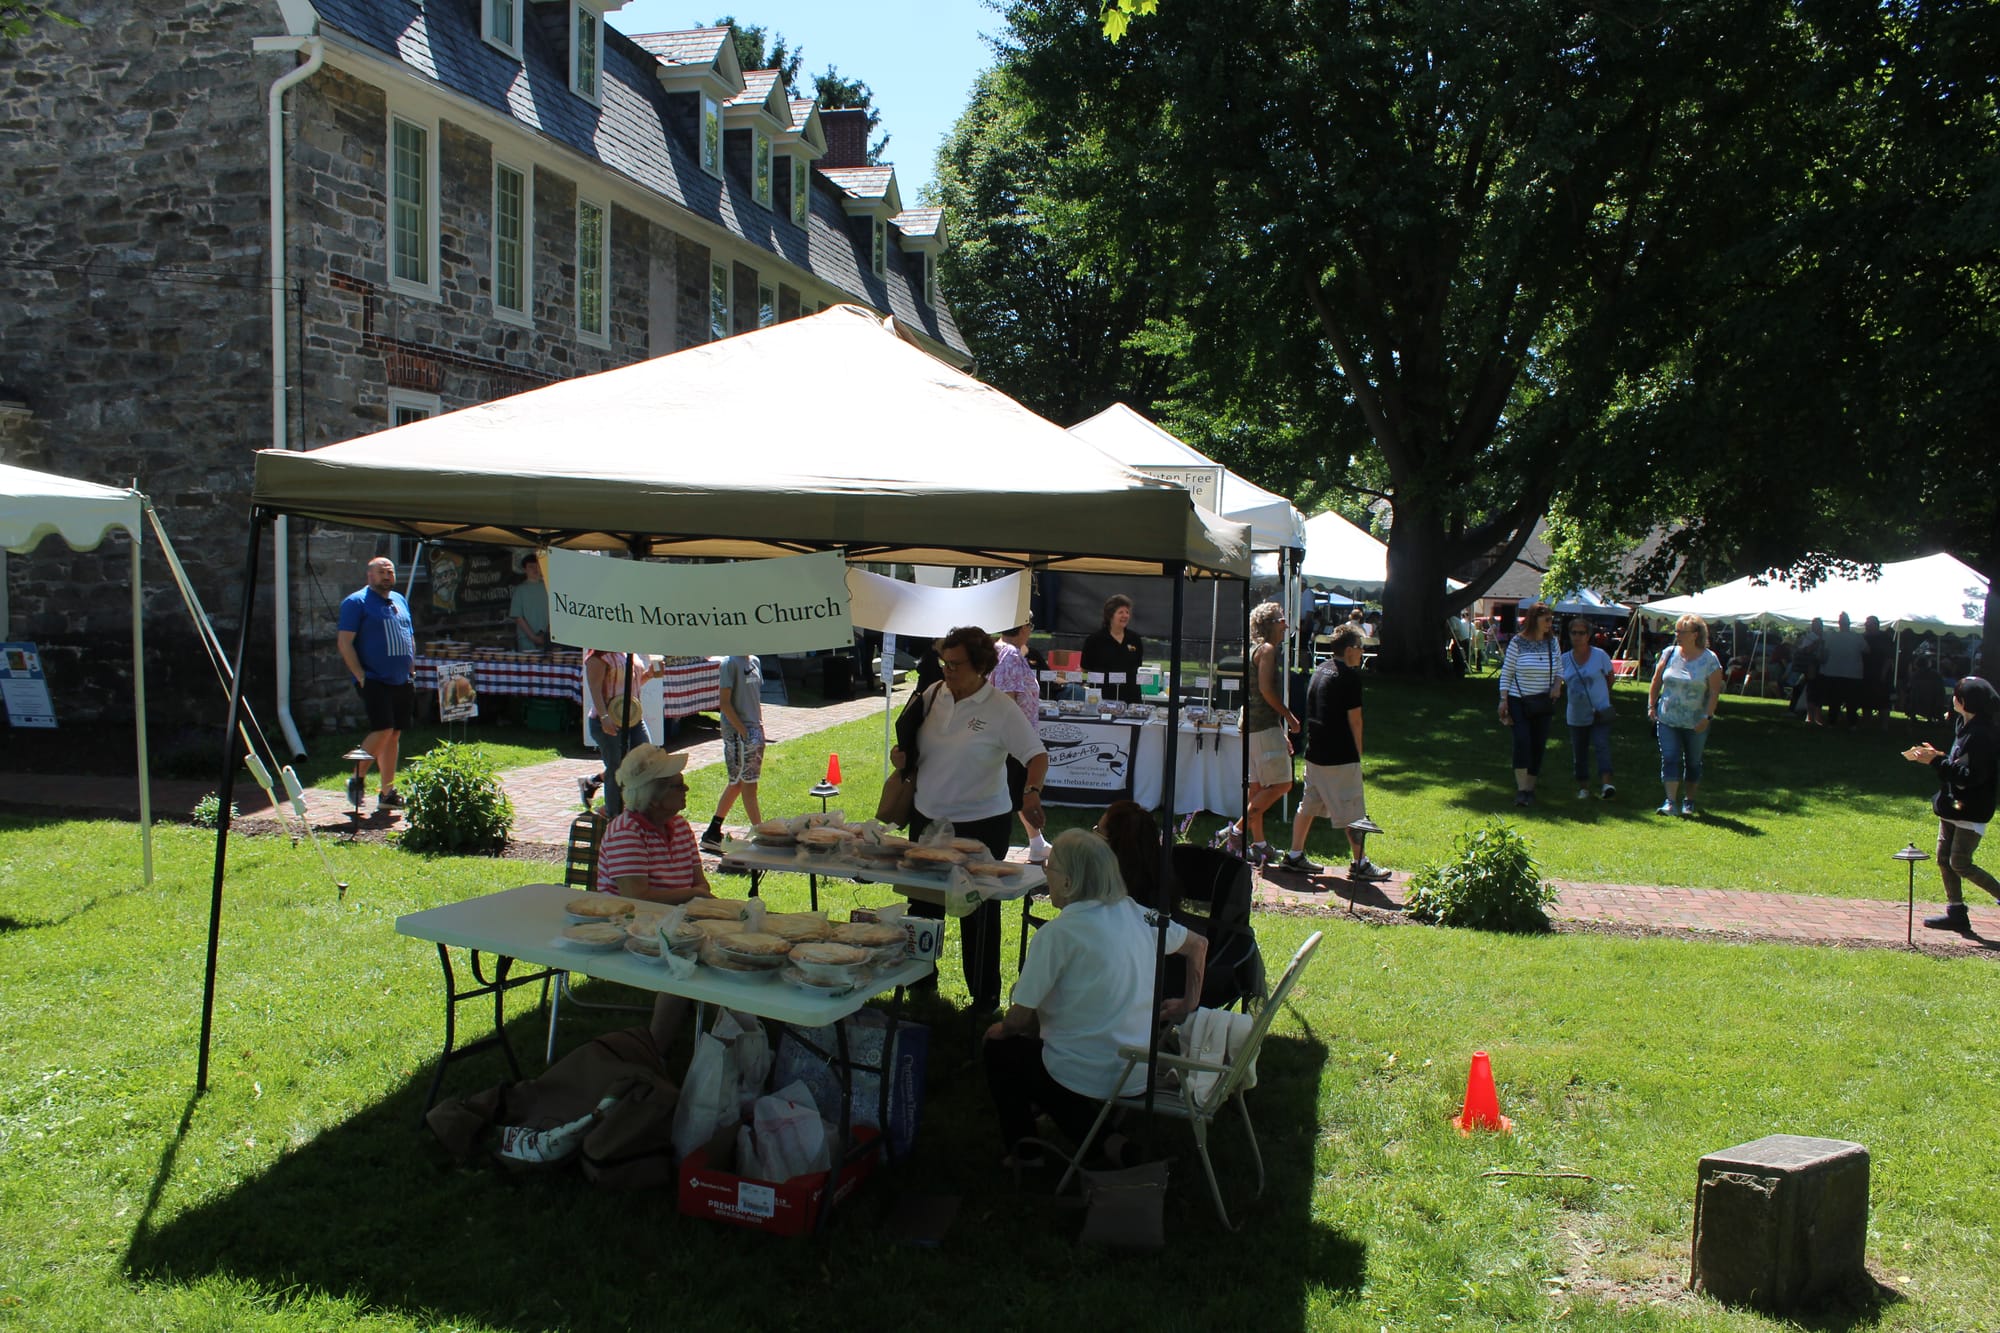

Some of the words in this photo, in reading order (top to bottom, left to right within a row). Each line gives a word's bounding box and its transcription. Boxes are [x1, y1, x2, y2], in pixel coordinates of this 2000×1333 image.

[1143, 471, 1180, 481] luten
[1185, 472, 1212, 483] Free
[553, 591, 634, 624] Nazareth
[640, 605, 747, 627] Moravian
[754, 596, 842, 623] Church
